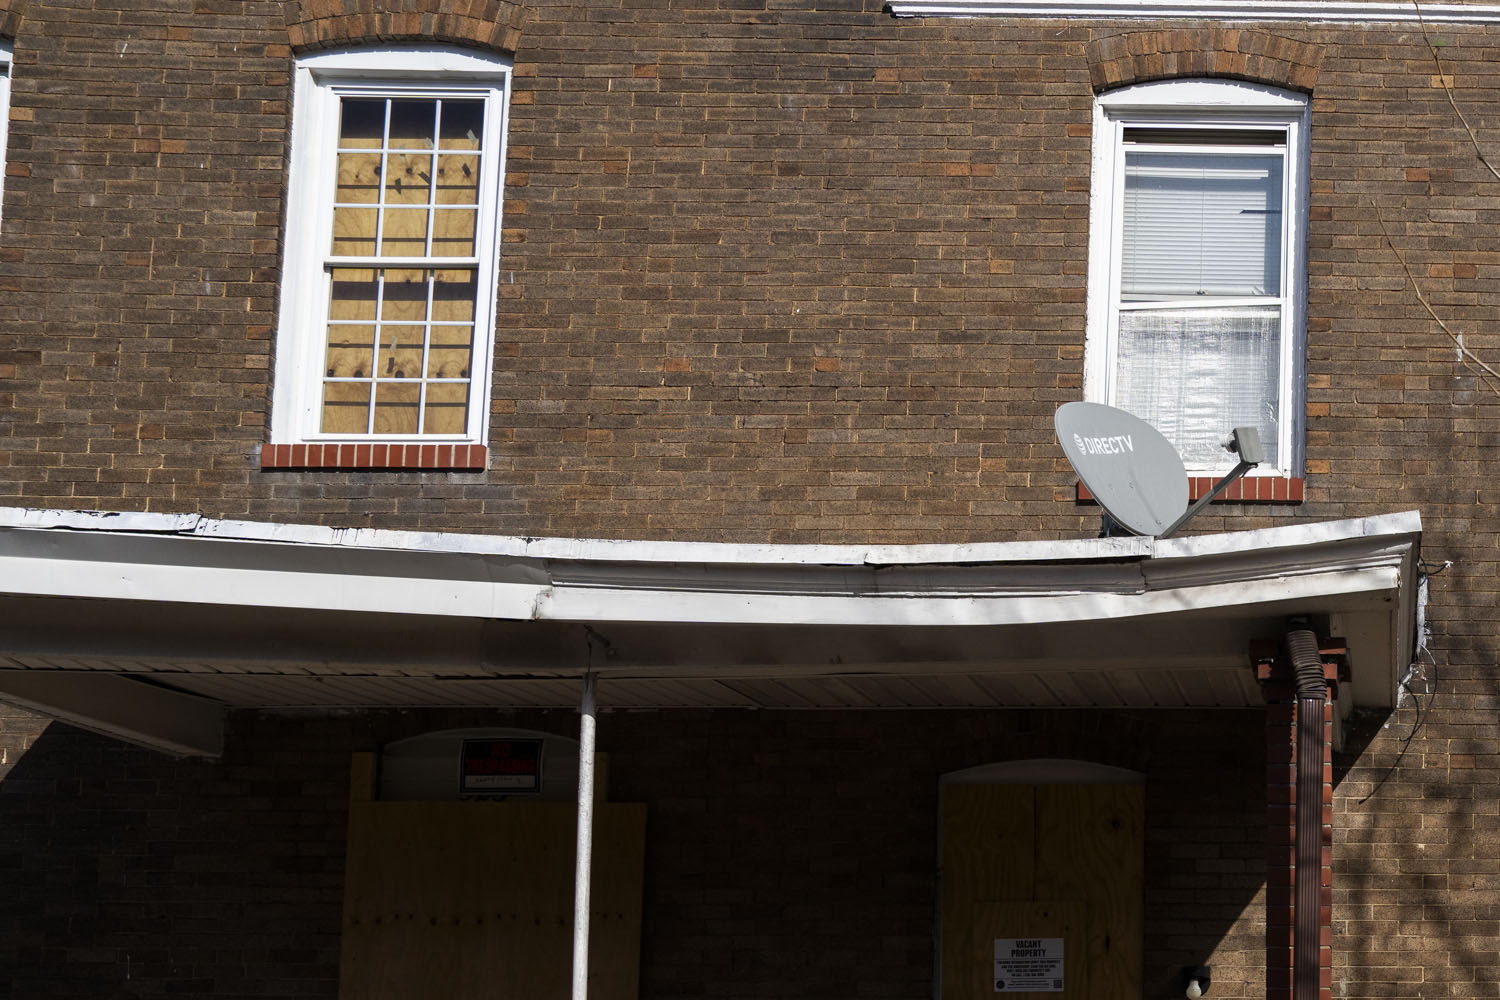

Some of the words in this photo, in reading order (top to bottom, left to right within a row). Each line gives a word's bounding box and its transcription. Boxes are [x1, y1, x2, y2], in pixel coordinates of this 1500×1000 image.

[1083, 434, 1134, 455] DIRECTV
[1015, 940, 1042, 949] VACANT
[1011, 949, 1046, 958] PROPERTY
